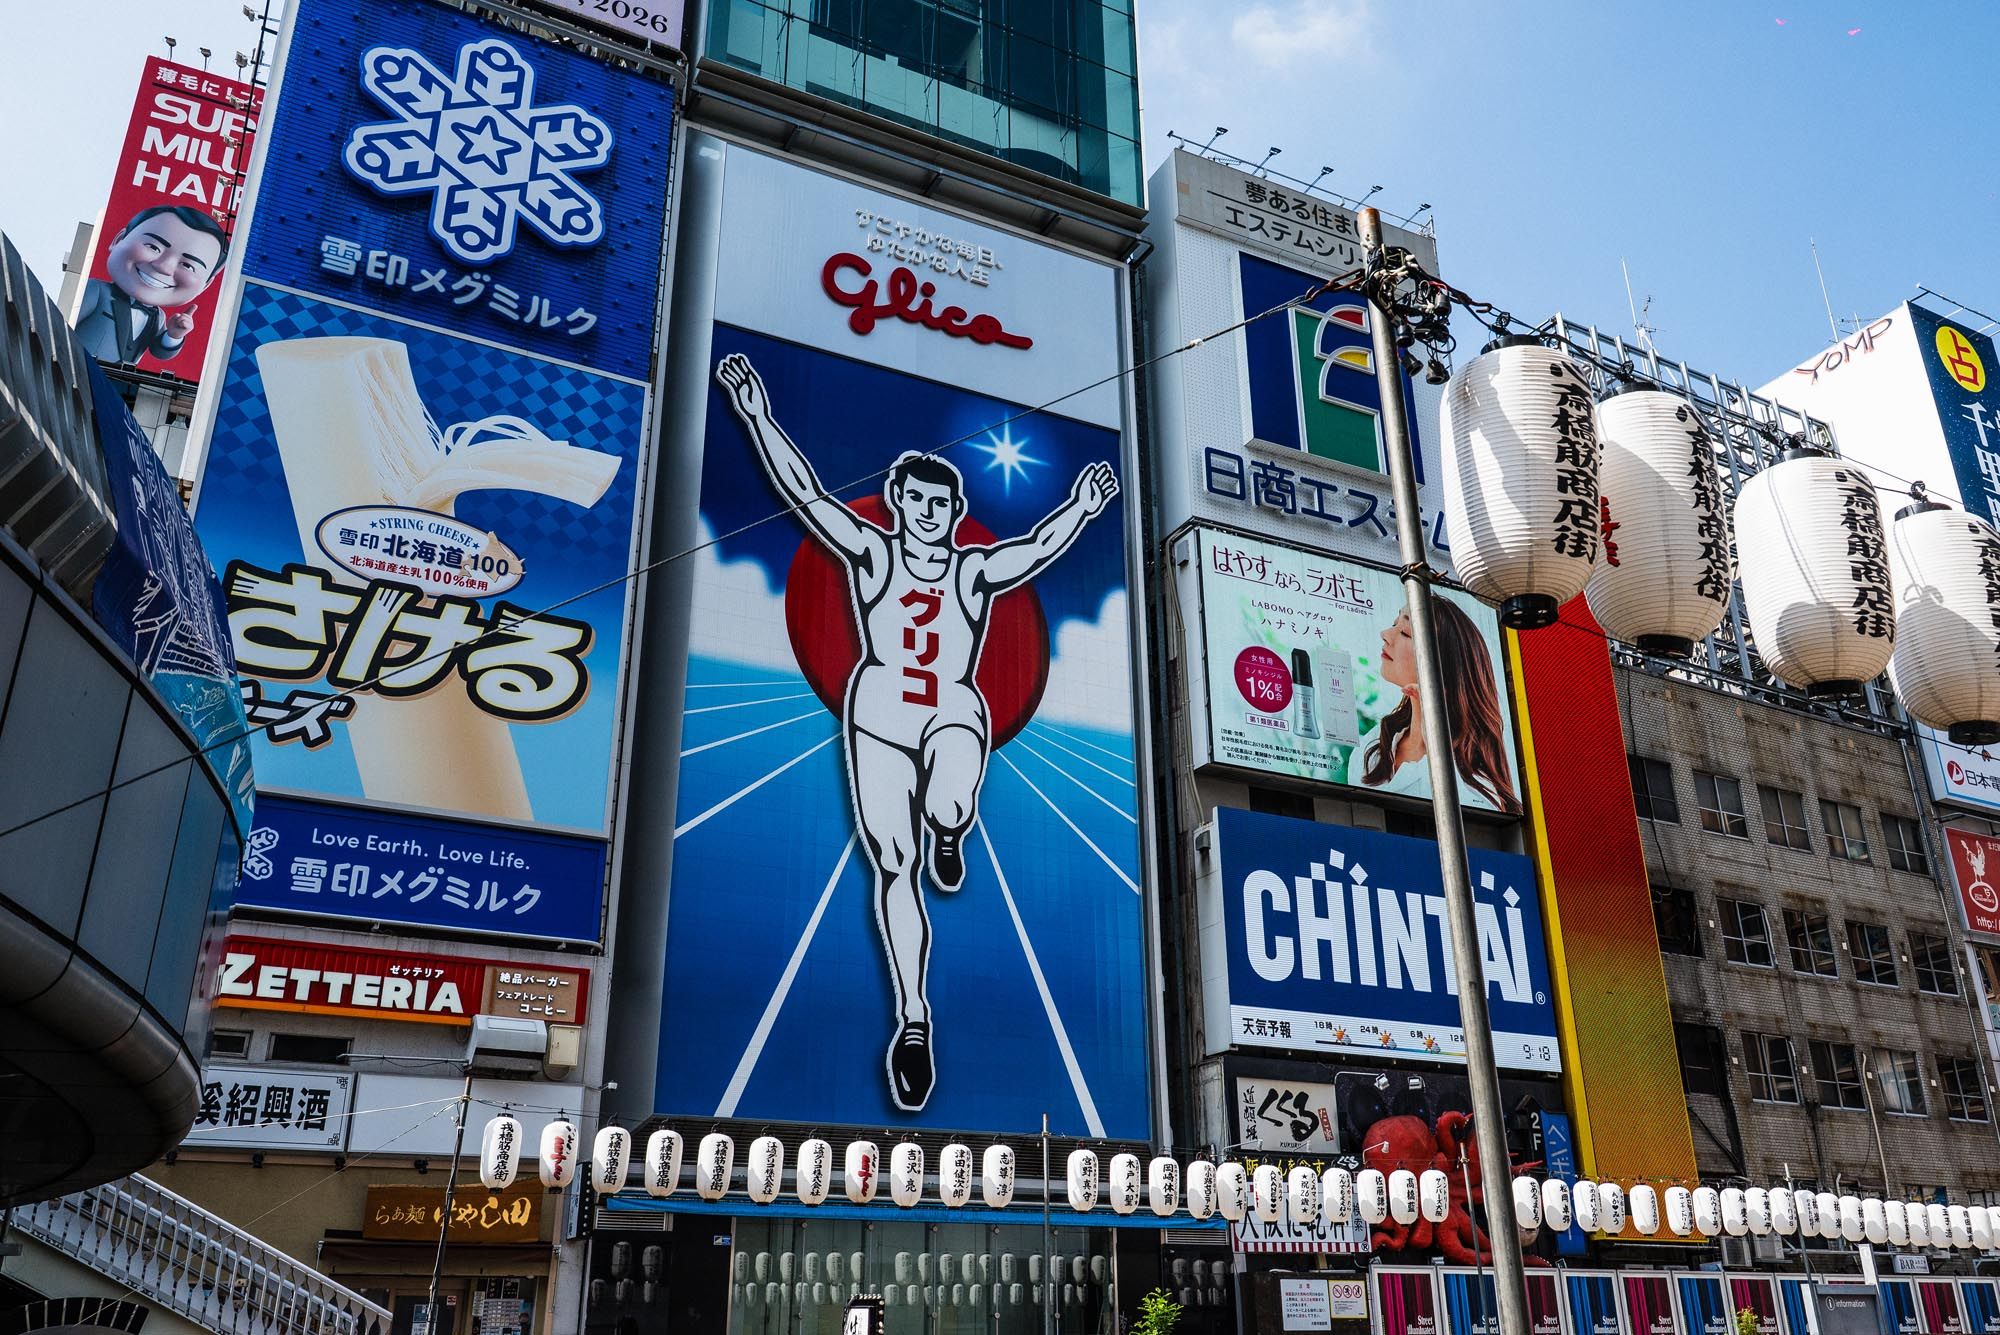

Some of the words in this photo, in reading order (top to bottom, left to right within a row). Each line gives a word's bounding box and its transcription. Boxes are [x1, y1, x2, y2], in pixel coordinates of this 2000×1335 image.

[593, 0, 668, 33] 2026
[855, 208, 1003, 270] すこやかな毎日、
[866, 232, 990, 288] ゆたかな人生
[320, 234, 600, 335] 雪印メグミルク
[821, 252, 1033, 350] Glico
[1947, 329, 1980, 387] 占
[1549, 361, 1598, 565] 心斎橋筋商店街
[1675, 403, 1731, 608] 心斎橋筋商店街
[339, 527, 509, 576] 雪印北海道100
[379, 517, 424, 531] STRING
[428, 522, 473, 547] CHEESE
[1834, 468, 1896, 644] 心斎橋筋商店街
[350, 555, 488, 591] 北海道産生乳100%使用
[1213, 545, 1373, 608] はやすなら、ラボモ。
[1251, 599, 1294, 615] LABOMO
[1297, 610, 1334, 623] ヘアグロウ
[1261, 618, 1324, 639] ハナミノキ
[223, 562, 593, 719] さける
[899, 587, 945, 708] グリコ
[1246, 677, 1275, 700] 1%
[240, 680, 356, 747] ーズ
[312, 828, 360, 849] Love
[366, 834, 429, 858] Earth.
[439, 844, 484, 866] Love
[490, 851, 530, 871] Life.
[289, 855, 542, 916] 雪印メグミルク
[1242, 848, 1534, 1005] CHINTAI
[221, 952, 464, 1014] ZETTERIA
[390, 964, 445, 979] ゼッテリア
[499, 972, 570, 987] 絶品バーガー
[497, 990, 555, 1003] フェアトレード
[520, 1003, 567, 1016] コーヒー
[1242, 1017, 1292, 1039] 天気予報
[1522, 1044, 1551, 1061] 9:18
[1257, 1088, 1320, 1142] くくる
[493, 1121, 514, 1182] 戎橋筋商店街
[603, 1131, 624, 1186] 戎橋筋商店街
[656, 1136, 675, 1189] 戎橋筋商店街
[710, 1139, 729, 1192] 戎橋筋商店街
[761, 1140, 778, 1196] 江崎グリコ株式会社
[809, 1142, 825, 1197] 江崎グリコ株式会社
[905, 1148, 918, 1193] 吉沢亮
[952, 1149, 966, 1198] 津田健次郎
[996, 1152, 1010, 1196] 志尊淳
[1081, 1155, 1093, 1202] 宮野真守
[1124, 1158, 1136, 1207] 木戸大聖
[1162, 1163, 1175, 1206] 岡崎体育
[375, 1204, 425, 1226] らぁ麺
[1900, 1259, 1915, 1270] BAR
[1417, 1315, 1433, 1325] Street
[1481, 1315, 1497, 1325] Seet
[1543, 1315, 1558, 1325] Street
[1836, 1300, 1866, 1308] information
